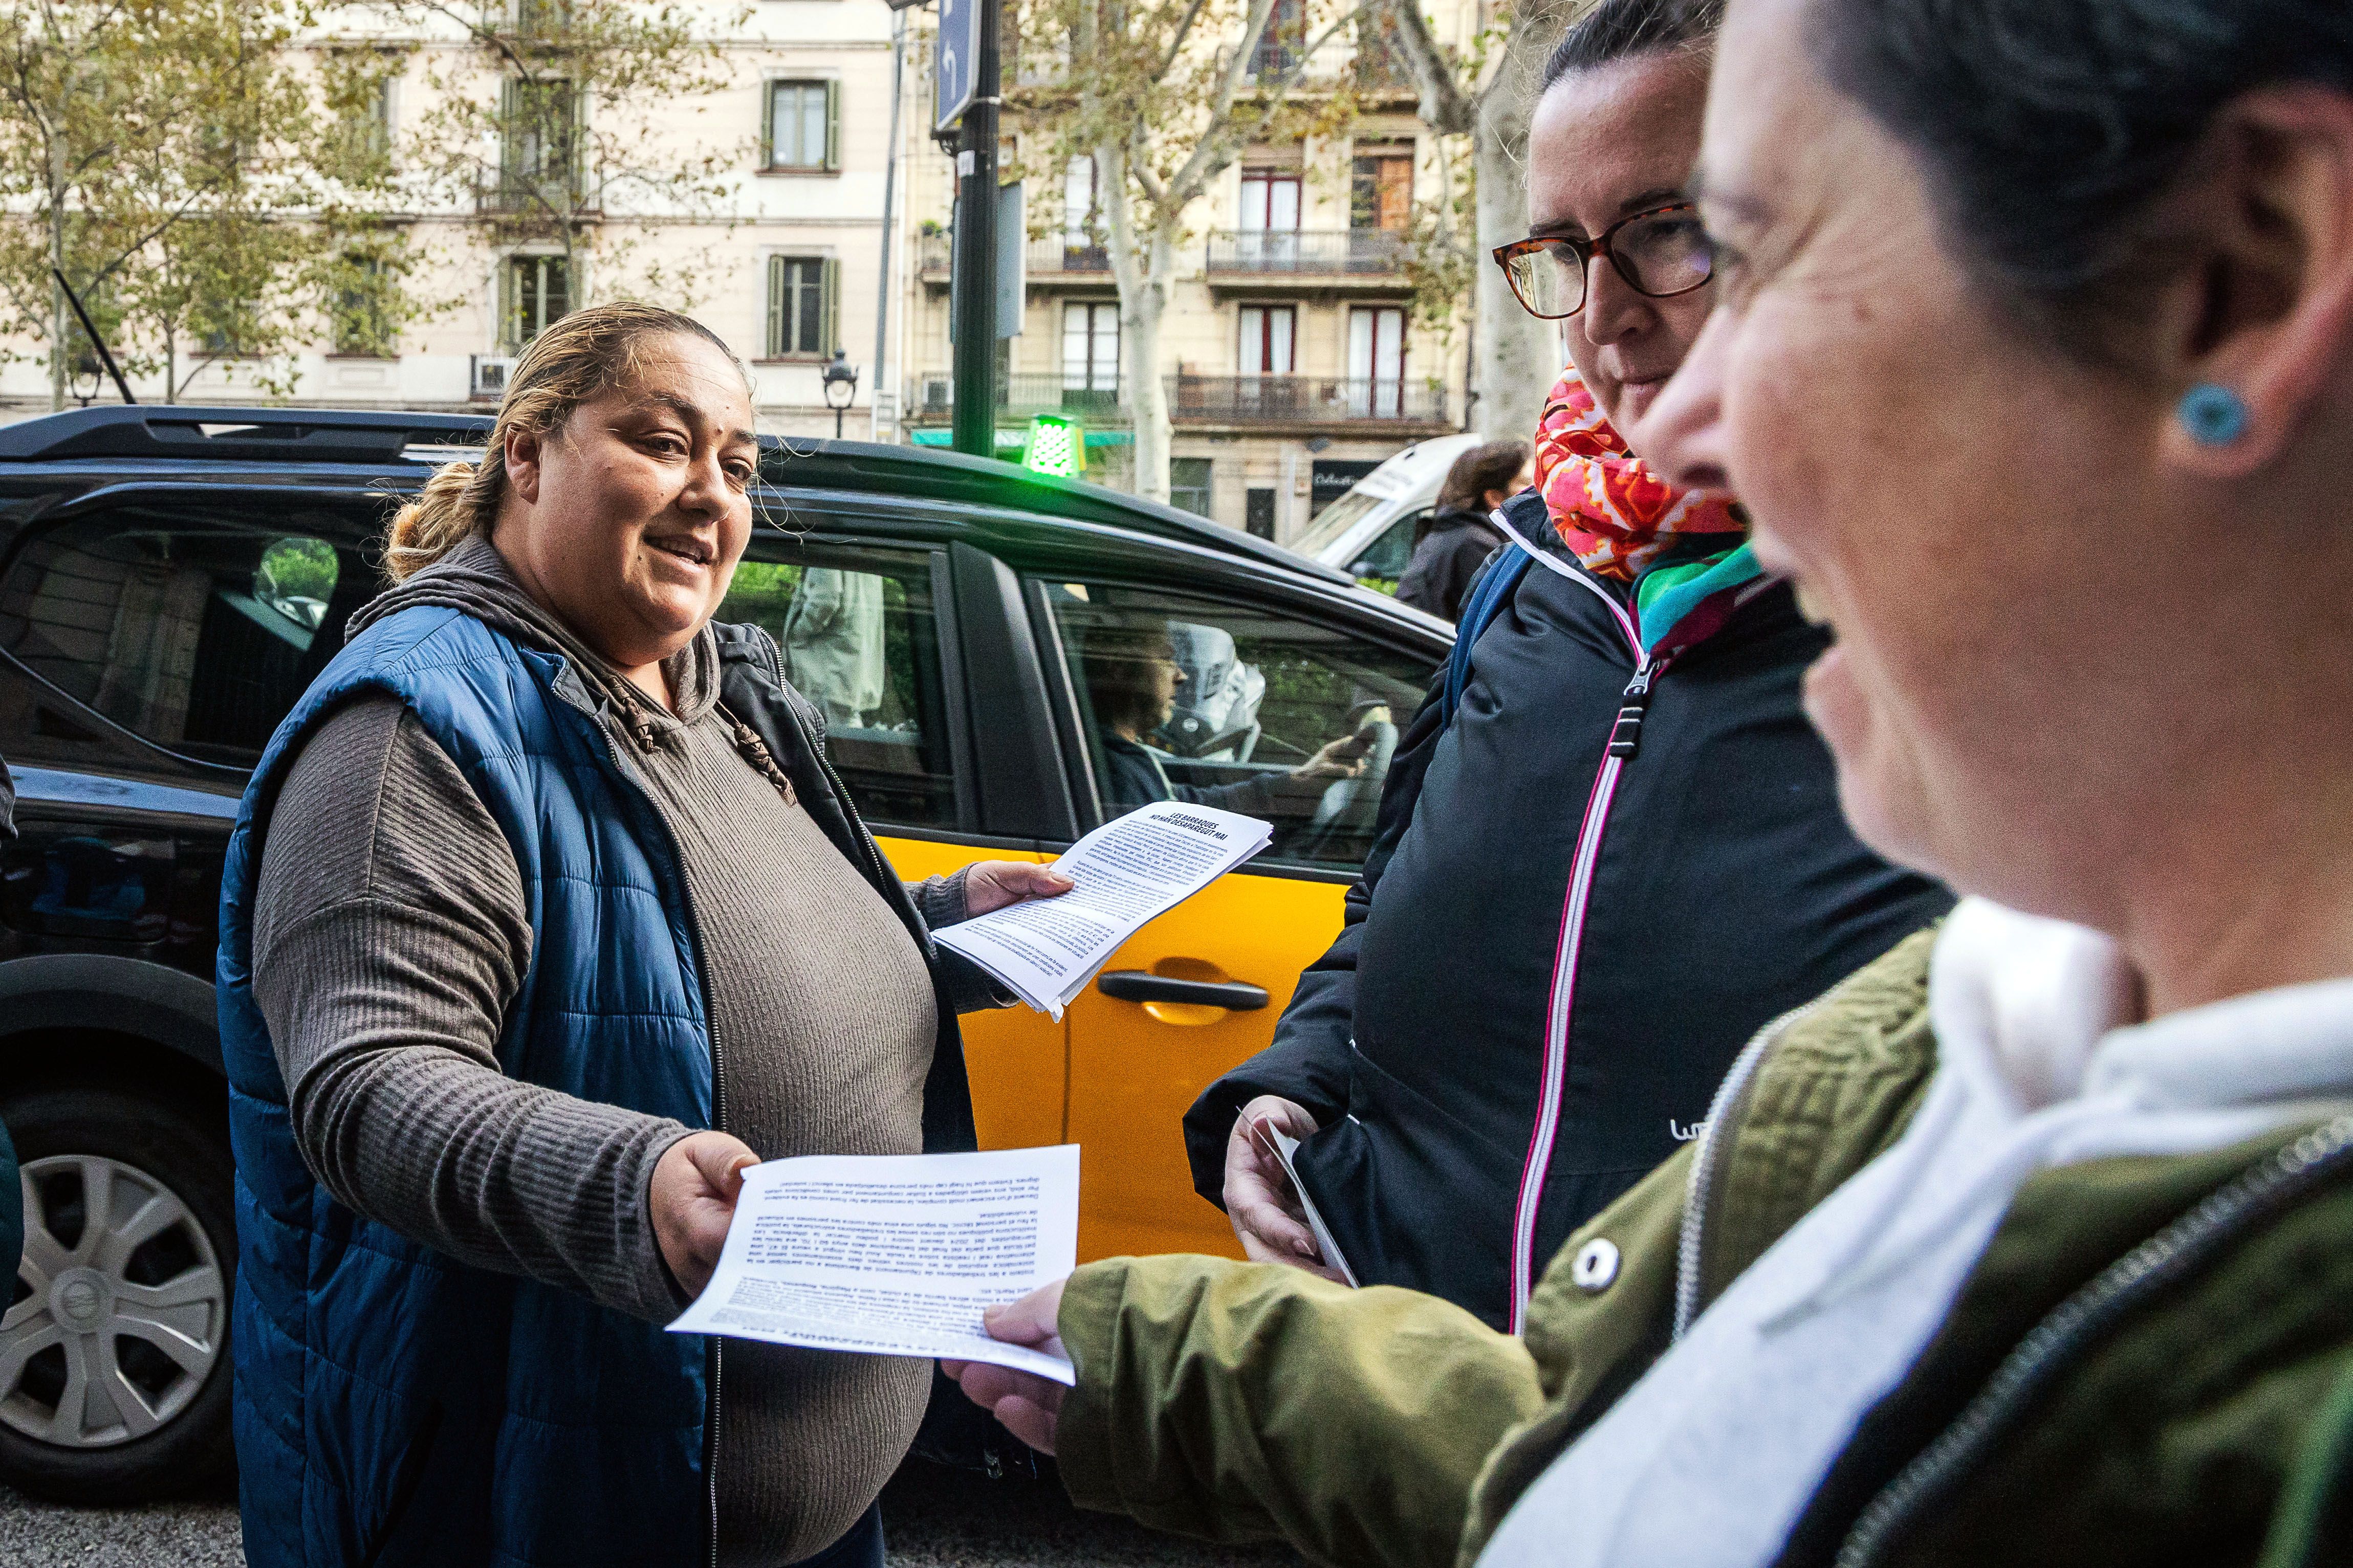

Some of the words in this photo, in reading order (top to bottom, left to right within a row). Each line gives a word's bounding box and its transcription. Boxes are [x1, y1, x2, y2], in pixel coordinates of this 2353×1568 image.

[1170, 819, 1215, 836] DESAPAREGUT
[1212, 832, 1228, 841] MAI
[1181, 814, 1219, 829] BARRAQUES
